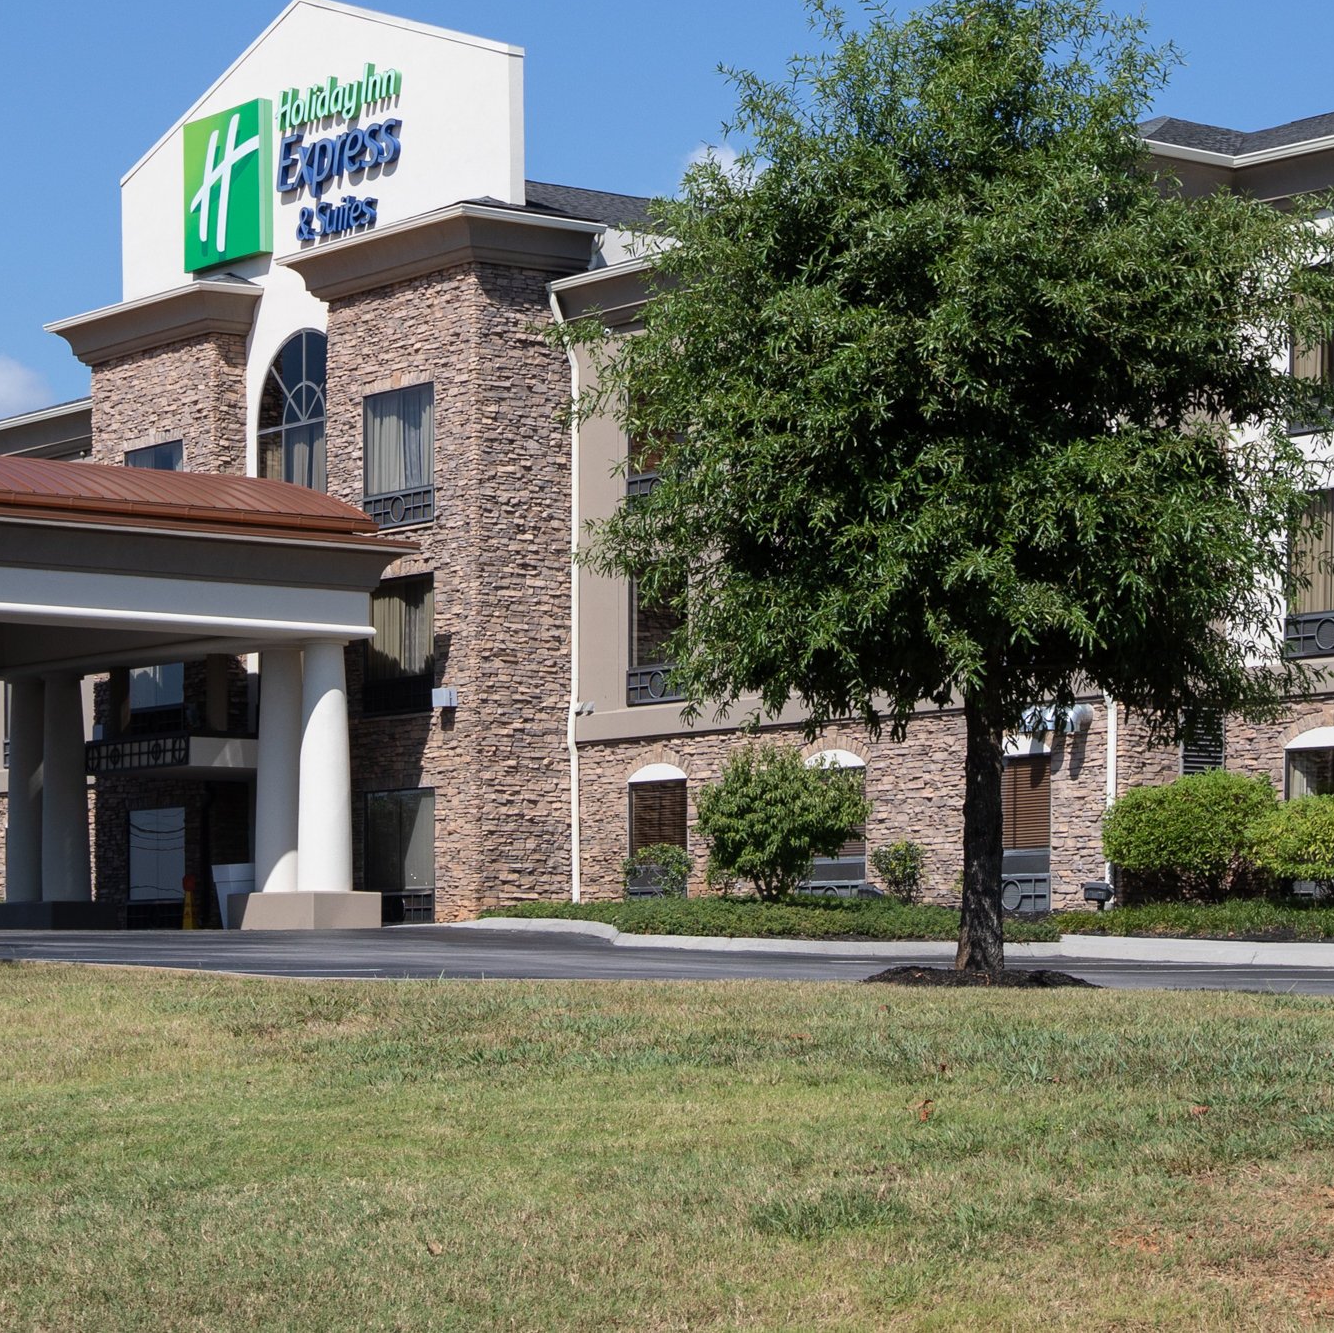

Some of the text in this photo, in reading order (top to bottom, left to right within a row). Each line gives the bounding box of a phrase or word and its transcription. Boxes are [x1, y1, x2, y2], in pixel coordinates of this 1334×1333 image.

[276, 62, 402, 132] Holiday Inn
[276, 118, 402, 199] Express
[296, 195, 378, 241] & Suites
